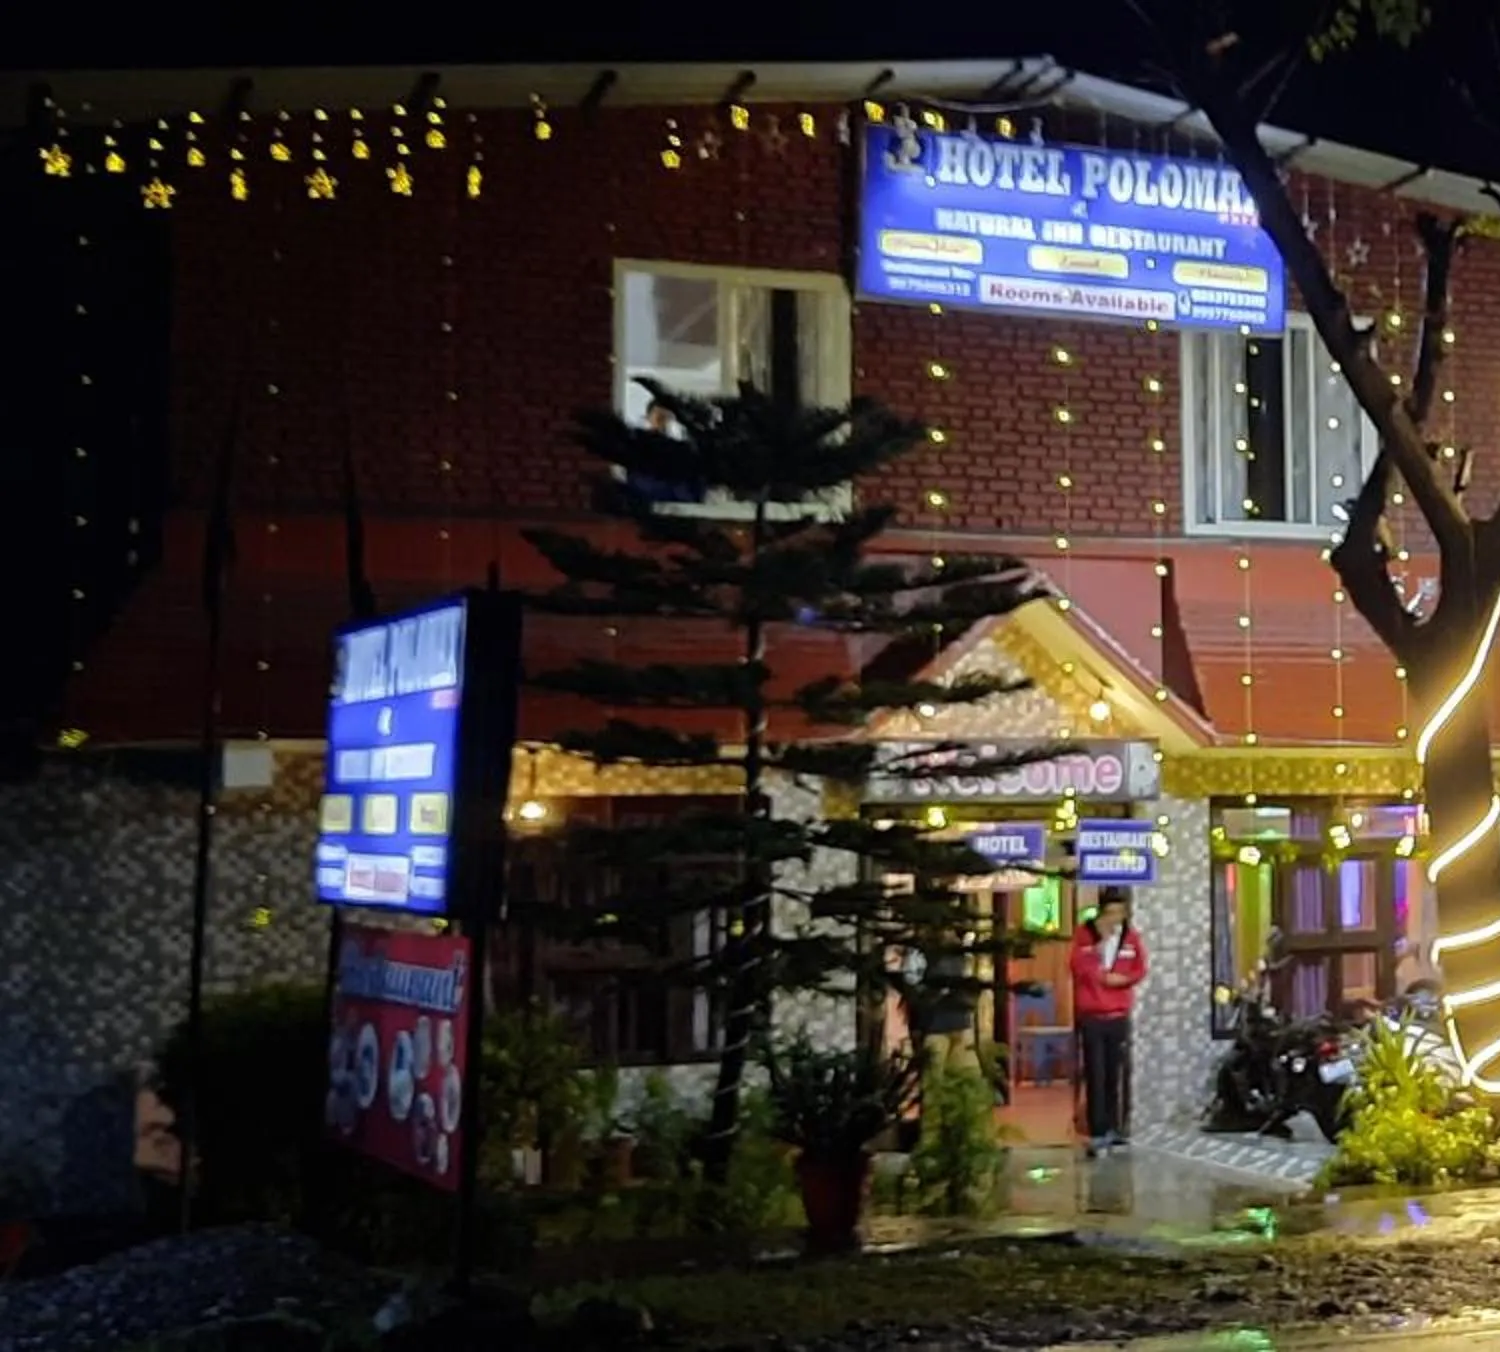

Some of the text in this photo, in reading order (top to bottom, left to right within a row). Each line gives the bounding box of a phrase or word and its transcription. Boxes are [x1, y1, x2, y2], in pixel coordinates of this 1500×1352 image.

[938, 137, 1070, 196] HOTEL
[934, 208, 1227, 258] NATURAL INN RESTAURANT
[989, 281, 1064, 303] Rooms
[1068, 288, 1170, 315] Available
[976, 834, 1029, 854] HOTEL
